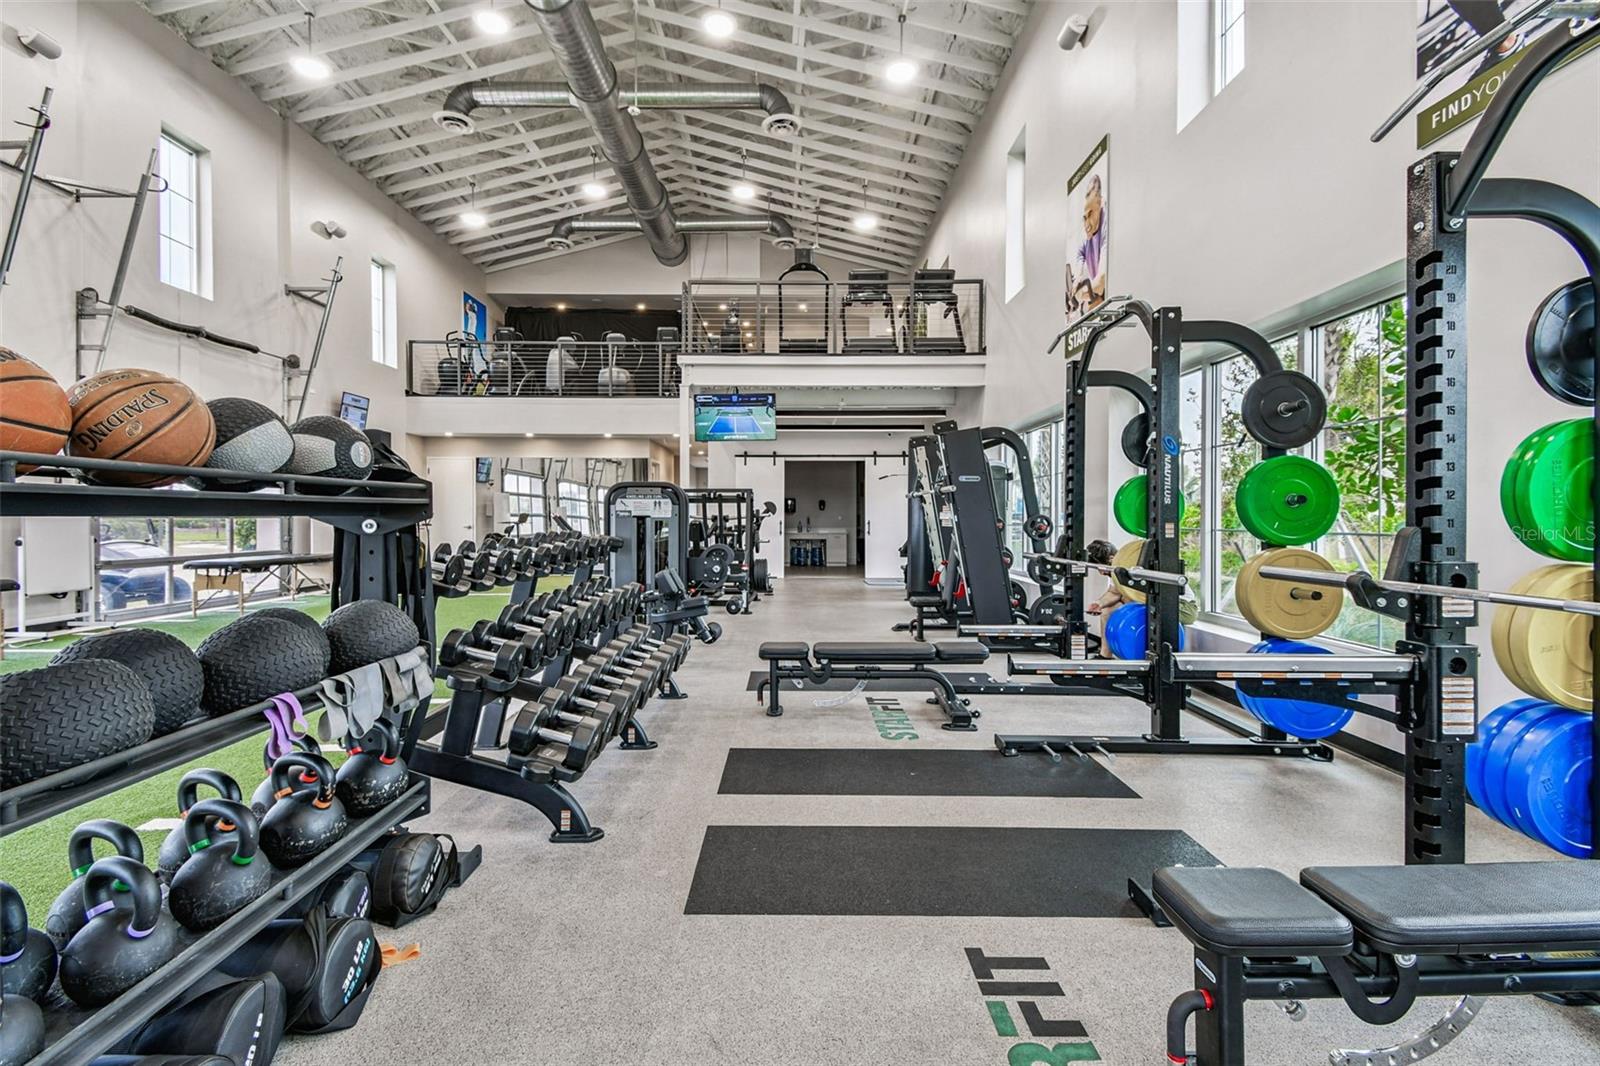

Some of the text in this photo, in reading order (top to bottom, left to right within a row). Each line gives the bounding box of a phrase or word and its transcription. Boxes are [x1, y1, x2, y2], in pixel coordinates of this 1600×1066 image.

[1445, 264, 1457, 275] 20
[1446, 292, 1456, 303] 19
[1446, 320, 1456, 331] 18
[1067, 326, 1094, 351] STAR
[1446, 349, 1456, 359] 17
[1446, 377, 1456, 387] 16
[1446, 406, 1456, 415] 15
[76, 388, 171, 453] SPALDING
[1446, 434, 1456, 444] 14
[1446, 462, 1456, 472] 13
[1163, 453, 1172, 505] NAUTILUS
[1446, 490, 1456, 500] 12
[1447, 518, 1455, 528] 11
[1446, 546, 1455, 556] 10
[1447, 631, 1454, 641] 7
[1446, 745, 1453, 755] 3
[341, 940, 364, 992] 30 LB
